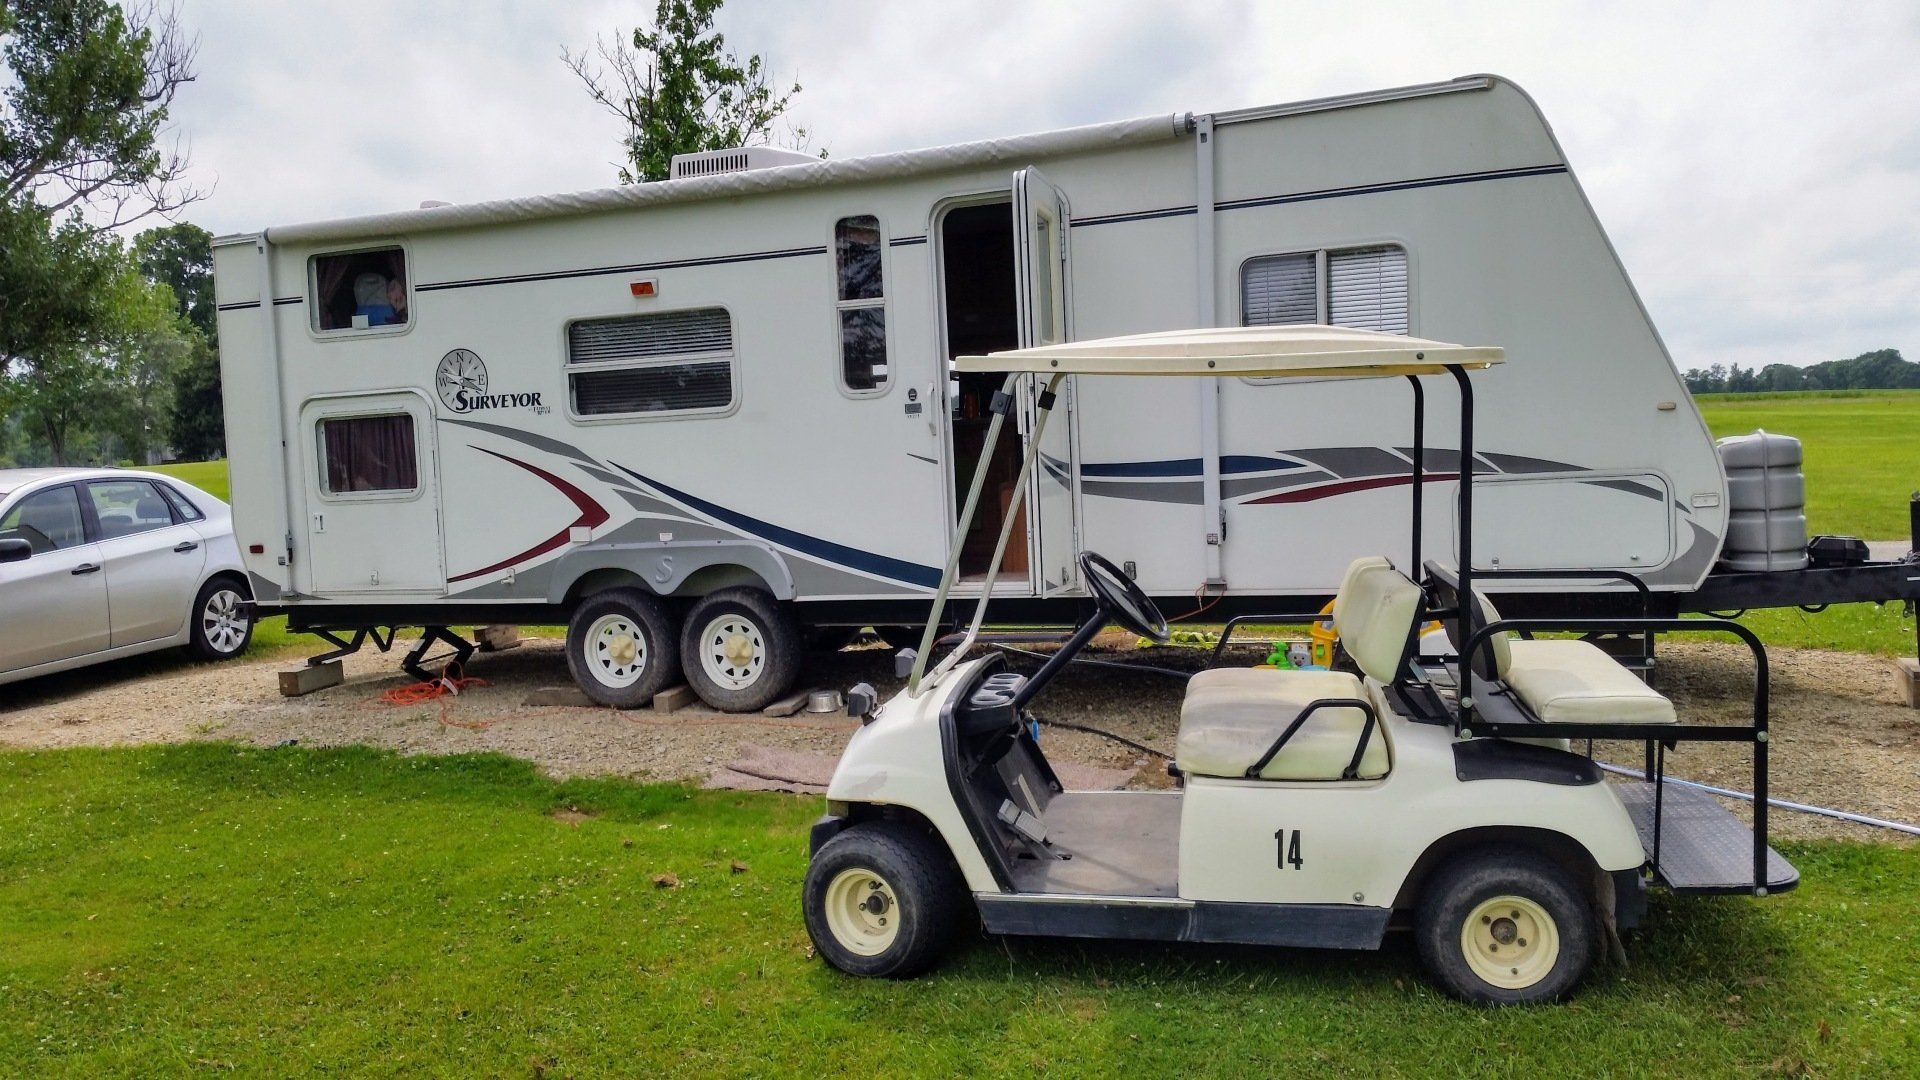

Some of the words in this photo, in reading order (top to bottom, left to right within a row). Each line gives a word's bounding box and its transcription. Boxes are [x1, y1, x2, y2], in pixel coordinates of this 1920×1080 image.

[456, 352, 464, 362] N
[439, 377, 448, 387] W
[478, 375, 486, 385] E
[455, 391, 542, 411] SURVEYOR
[1275, 829, 1303, 870] 14
